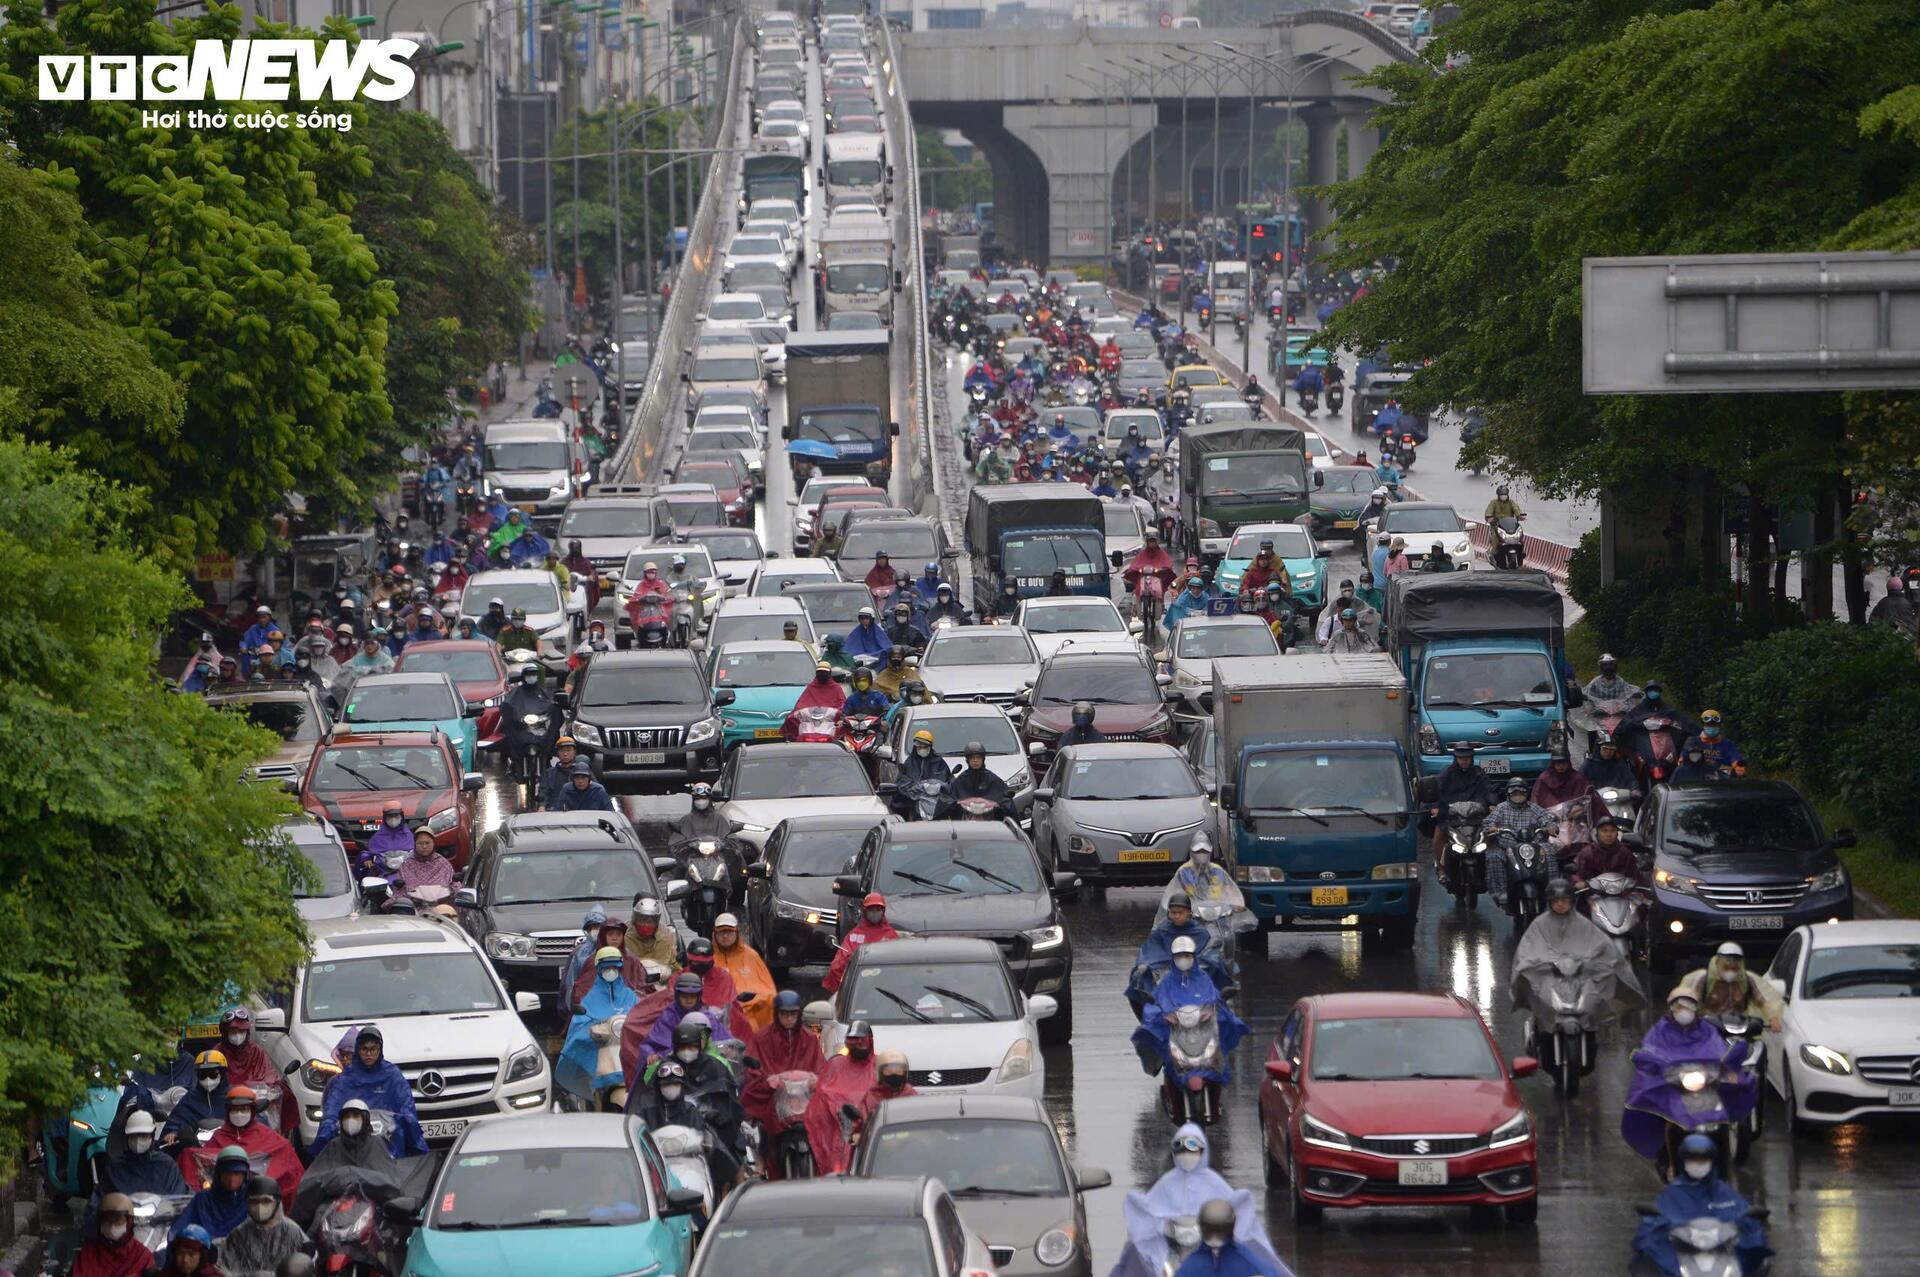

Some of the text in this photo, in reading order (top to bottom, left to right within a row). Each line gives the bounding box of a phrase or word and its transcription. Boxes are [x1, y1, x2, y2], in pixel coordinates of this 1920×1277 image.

[1065, 575, 1084, 586] HÍNH
[1321, 888, 1337, 896] 29C
[425, 1122, 463, 1137] -524.39
